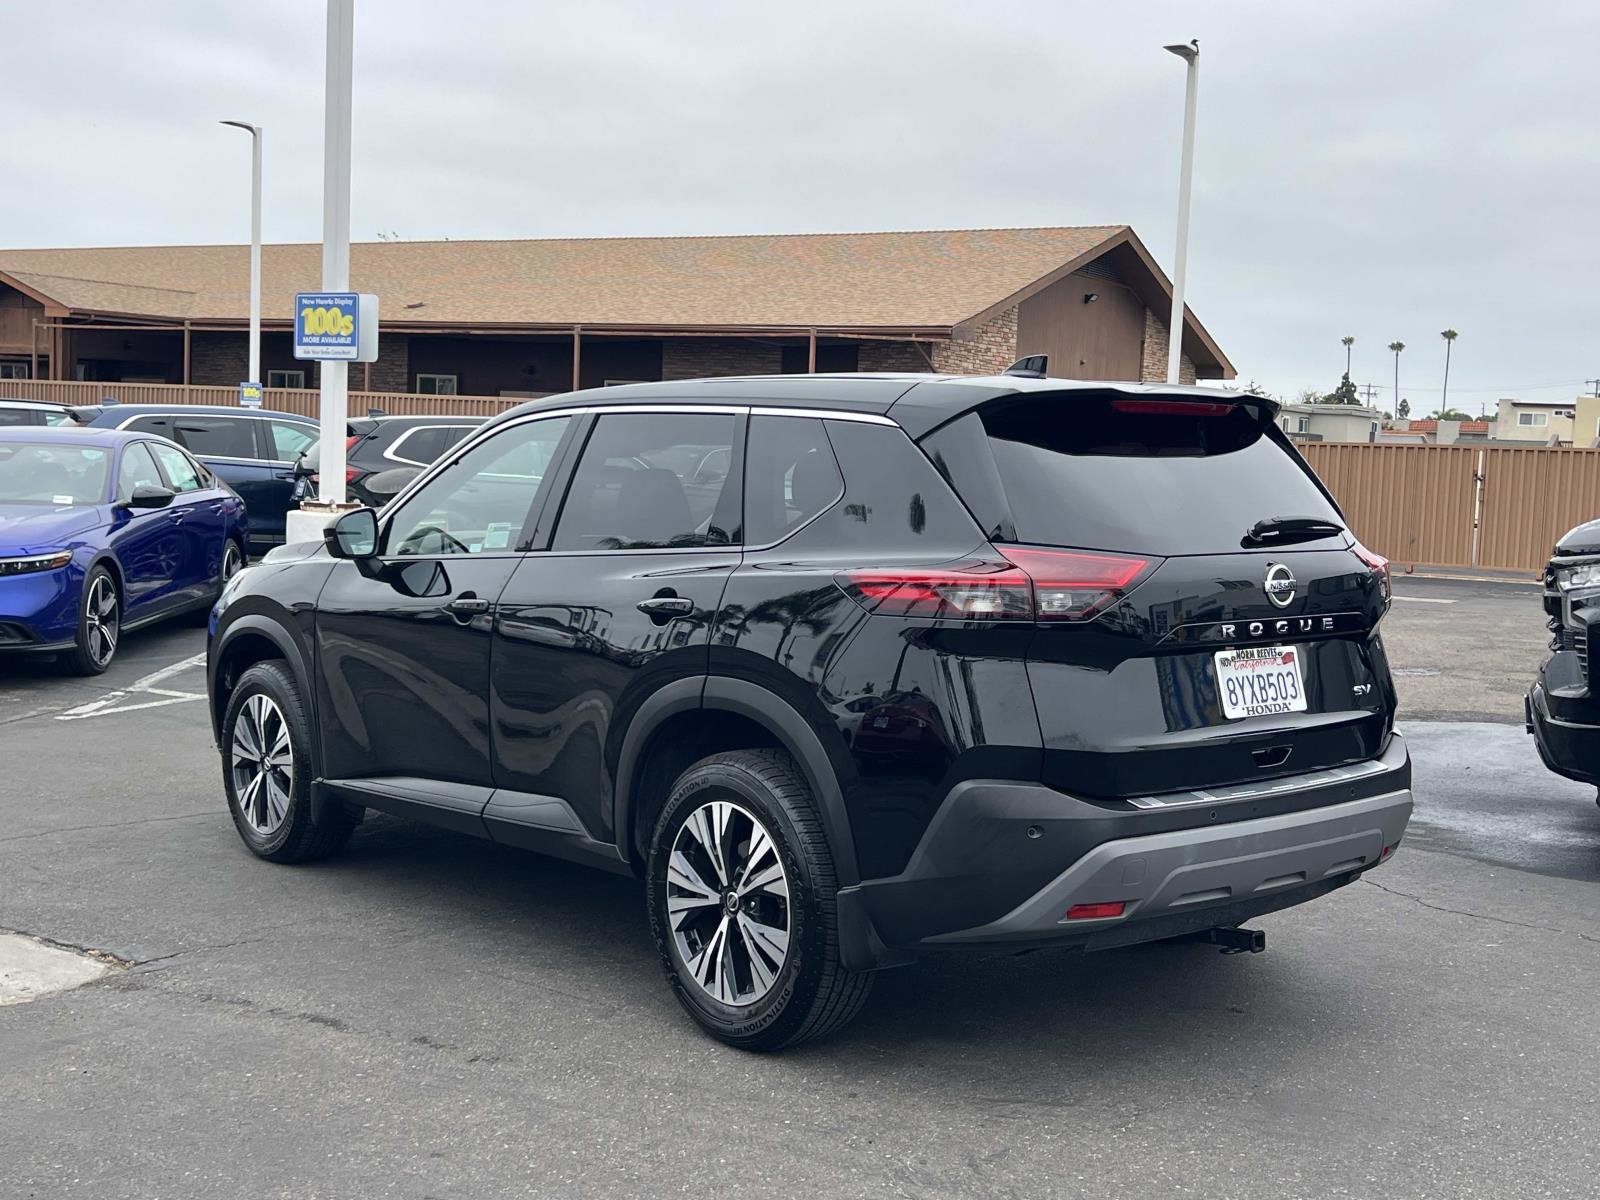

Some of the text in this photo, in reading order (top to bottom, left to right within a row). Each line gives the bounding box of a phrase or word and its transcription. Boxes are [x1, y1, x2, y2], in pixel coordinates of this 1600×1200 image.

[335, 298, 353, 306] Display
[301, 307, 354, 336] 100s
[1221, 617, 1335, 638] ROGUE
[1236, 648, 1276, 659] NORM REEVES
[1234, 659, 1277, 670] California
[1226, 671, 1298, 706] 8YXB503
[1353, 683, 1371, 696] SV
[1246, 702, 1290, 715] HONDA
